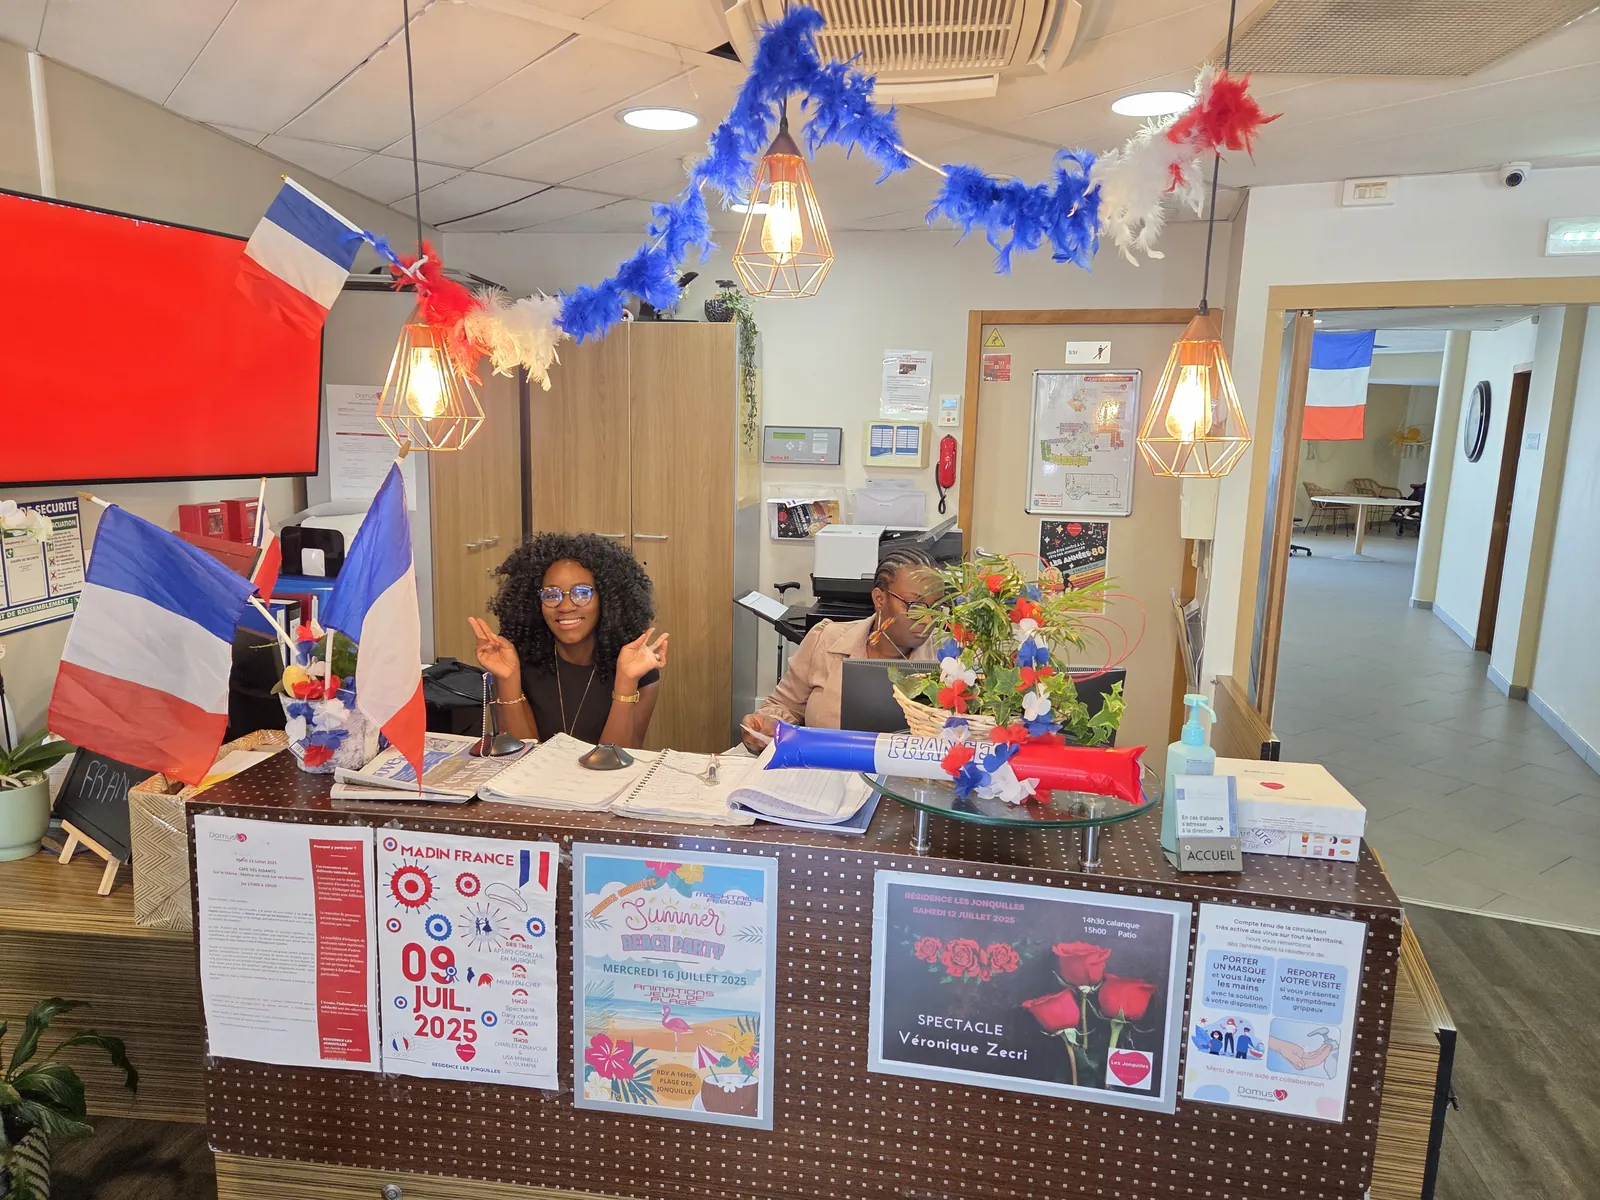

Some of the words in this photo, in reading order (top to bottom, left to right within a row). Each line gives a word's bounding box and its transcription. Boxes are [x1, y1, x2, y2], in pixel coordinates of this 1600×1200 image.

[35, 501, 78, 514] SECURITE
[1091, 546, 1105, 556] 80
[17, 598, 69, 615] RASSEMBLEMENT
[79, 760, 141, 803] FRAN
[209, 831, 236, 840] Domus
[401, 844, 450, 860] MADIN
[454, 849, 514, 866] FRANCE
[1187, 850, 1235, 861] ACCUEIL
[904, 892, 953, 904] RÉSIDENCE
[954, 897, 969, 905] LES
[971, 899, 1024, 911] JONQUILLES
[622, 897, 726, 936] Summer
[913, 906, 946, 916] SAMEDI
[958, 912, 992, 921] JUILLET
[992, 915, 1015, 924] 2025
[1082, 916, 1105, 925] 14h30
[1106, 920, 1140, 929] calanque
[1084, 926, 1106, 935] 15h00
[1118, 930, 1137, 938] Patio
[1292, 926, 1327, 935] circulation
[621, 934, 671, 953] BEACH
[672, 936, 725, 960] PARTY
[1240, 942, 1261, 950] l'entrée
[1285, 948, 1315, 957] résidence
[1277, 940, 1311, 949] remercions
[510, 956, 536, 965] MUSIQUE
[515, 950, 544, 959] COCKTAIL
[1222, 954, 1259, 966] PORTER
[402, 942, 456, 984] 09
[1228, 964, 1266, 975] MASQUE
[603, 964, 658, 977] MERCREDI
[662, 970, 674, 979] 16
[676, 971, 718, 983] JUILLET
[721, 975, 747, 986] 2025
[1244, 975, 1266, 984] laver
[1287, 968, 1336, 980] REPORTER
[1232, 983, 1259, 992] mains
[1280, 976, 1310, 986] VOTRE
[1312, 980, 1341, 990] VISITE
[634, 984, 714, 997] ANIMATIONS
[1304, 991, 1340, 999] présentez
[413, 985, 471, 1014] JUIL.
[651, 997, 696, 1006] PLAGE
[1236, 994, 1263, 1002] solution
[1296, 997, 1336, 1007] symptômes
[1230, 1000, 1268, 1011] disposition
[414, 1014, 478, 1043] 2025
[918, 1014, 1003, 1036] SPECTACLE
[899, 1031, 979, 1055] Véronique
[986, 1042, 1028, 1060] Zecri
[1206, 1065, 1224, 1073] Merci
[1279, 1076, 1324, 1088] collaboration
[656, 1086, 695, 1095] JONQUILLES
[1237, 1085, 1273, 1098] Domus
